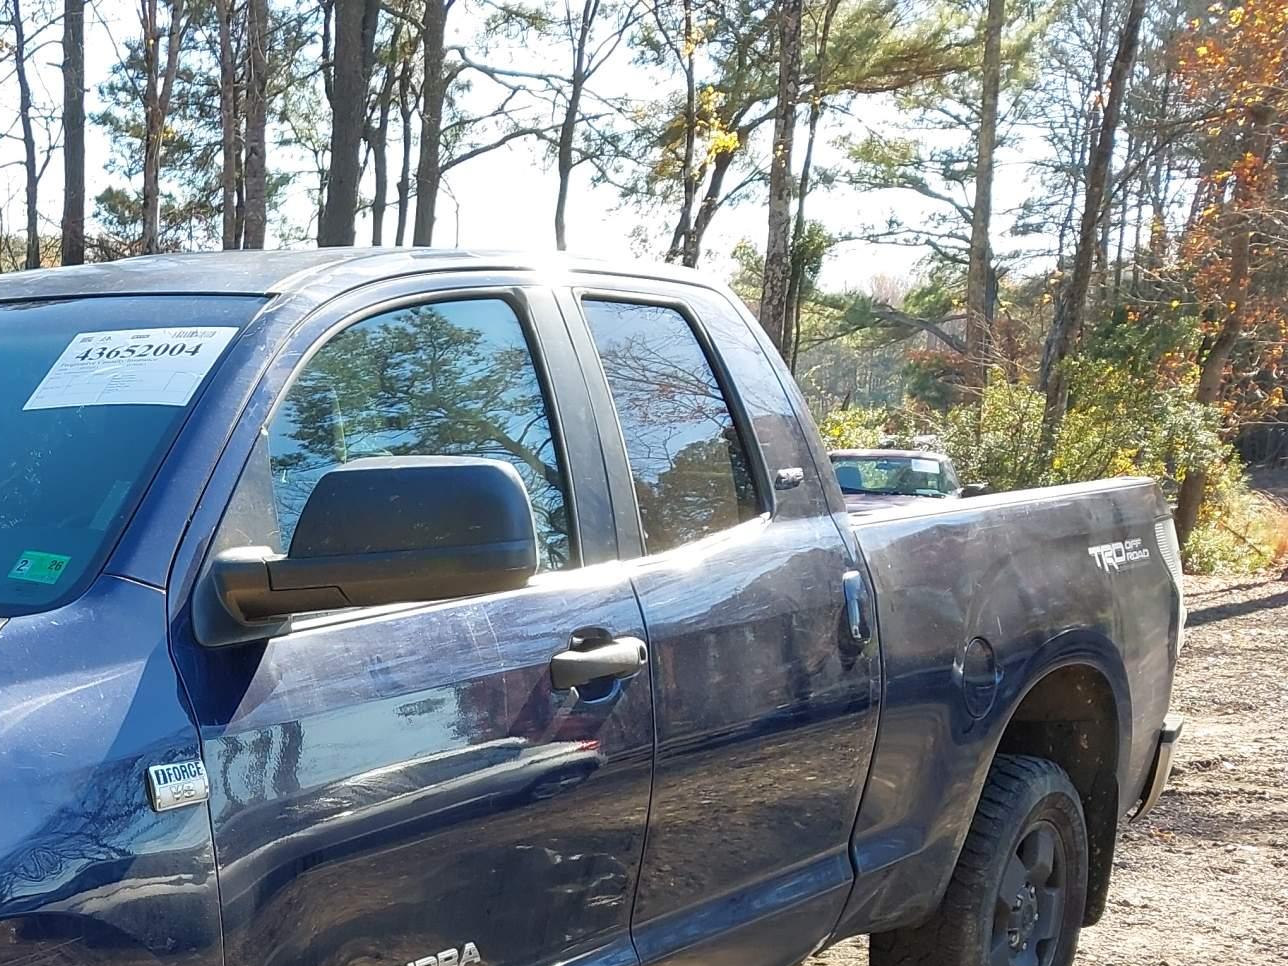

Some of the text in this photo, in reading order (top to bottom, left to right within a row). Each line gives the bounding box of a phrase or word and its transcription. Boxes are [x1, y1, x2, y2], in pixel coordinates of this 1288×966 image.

[76, 342, 203, 361] 43652004
[1124, 538, 1142, 550] OFF
[1088, 542, 1126, 574] TRD
[1126, 549, 1150, 561] ROAD
[16, 560, 64, 572] 2 26
